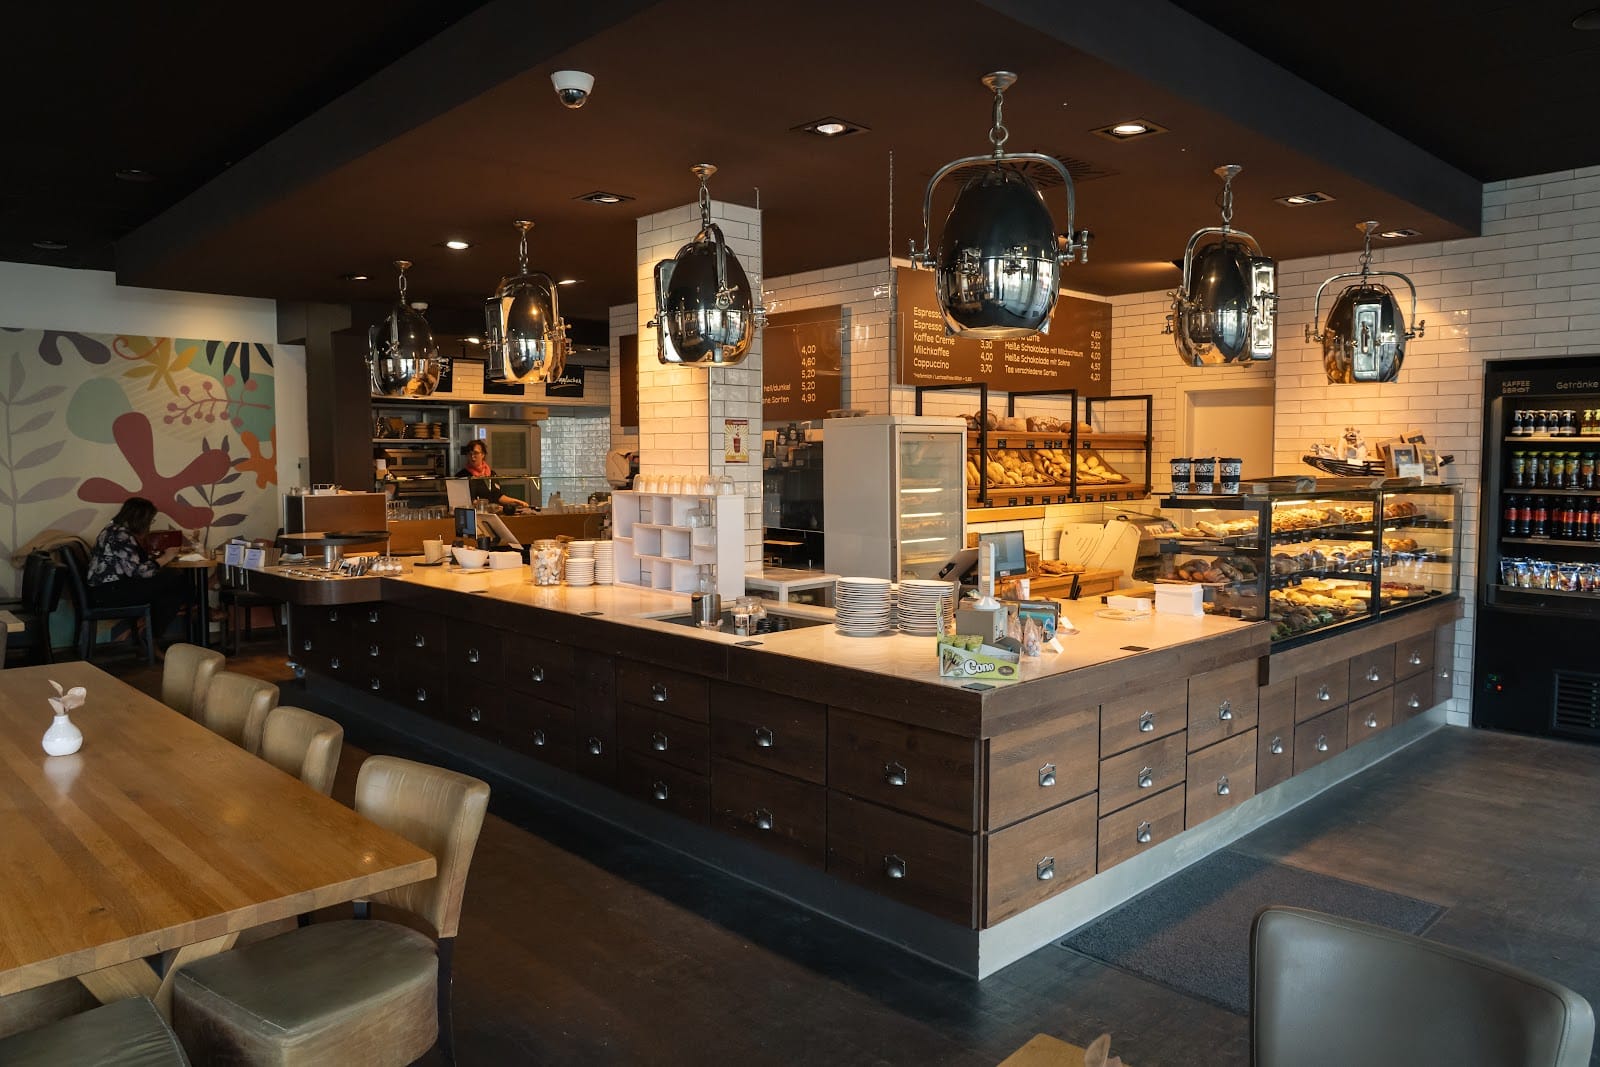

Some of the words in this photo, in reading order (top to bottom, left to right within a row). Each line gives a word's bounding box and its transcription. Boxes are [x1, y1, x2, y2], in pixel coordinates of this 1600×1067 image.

[913, 319, 942, 331] Espresso
[913, 332, 934, 343] Kaffee
[801, 344, 816, 355] 4,00
[980, 340, 993, 350] 3,30
[1021, 343, 1050, 354] Schokolade
[913, 345, 950, 357] Milchkaffee
[980, 352, 993, 361] 4,00
[913, 357, 950, 369] Cappuccino
[1021, 354, 1050, 365] Schokolade
[801, 369, 816, 379] 5,20
[980, 363, 993, 374] 3,70
[801, 381, 816, 391] 5,20
[1502, 380, 1530, 388] KAFFEE
[1556, 380, 1599, 390] Getränke
[772, 395, 790, 404] Sorten
[964, 659, 995, 675] Cono
